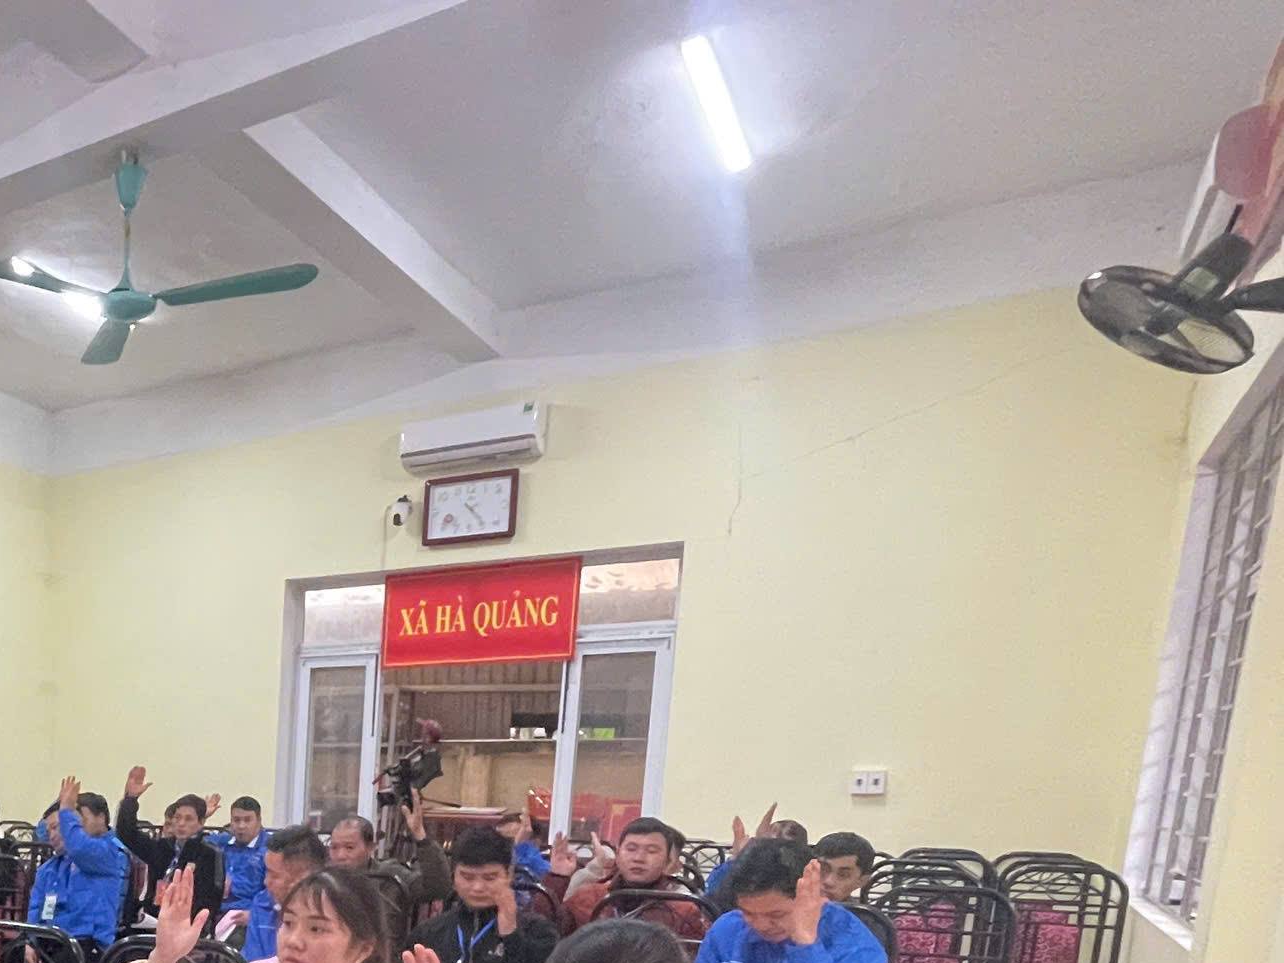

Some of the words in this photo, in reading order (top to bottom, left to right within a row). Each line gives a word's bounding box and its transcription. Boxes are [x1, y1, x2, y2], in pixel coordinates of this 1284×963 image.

[398, 599, 429, 637] XÃ
[435, 595, 467, 634] HÀ
[473, 590, 559, 638] QUẢNG
